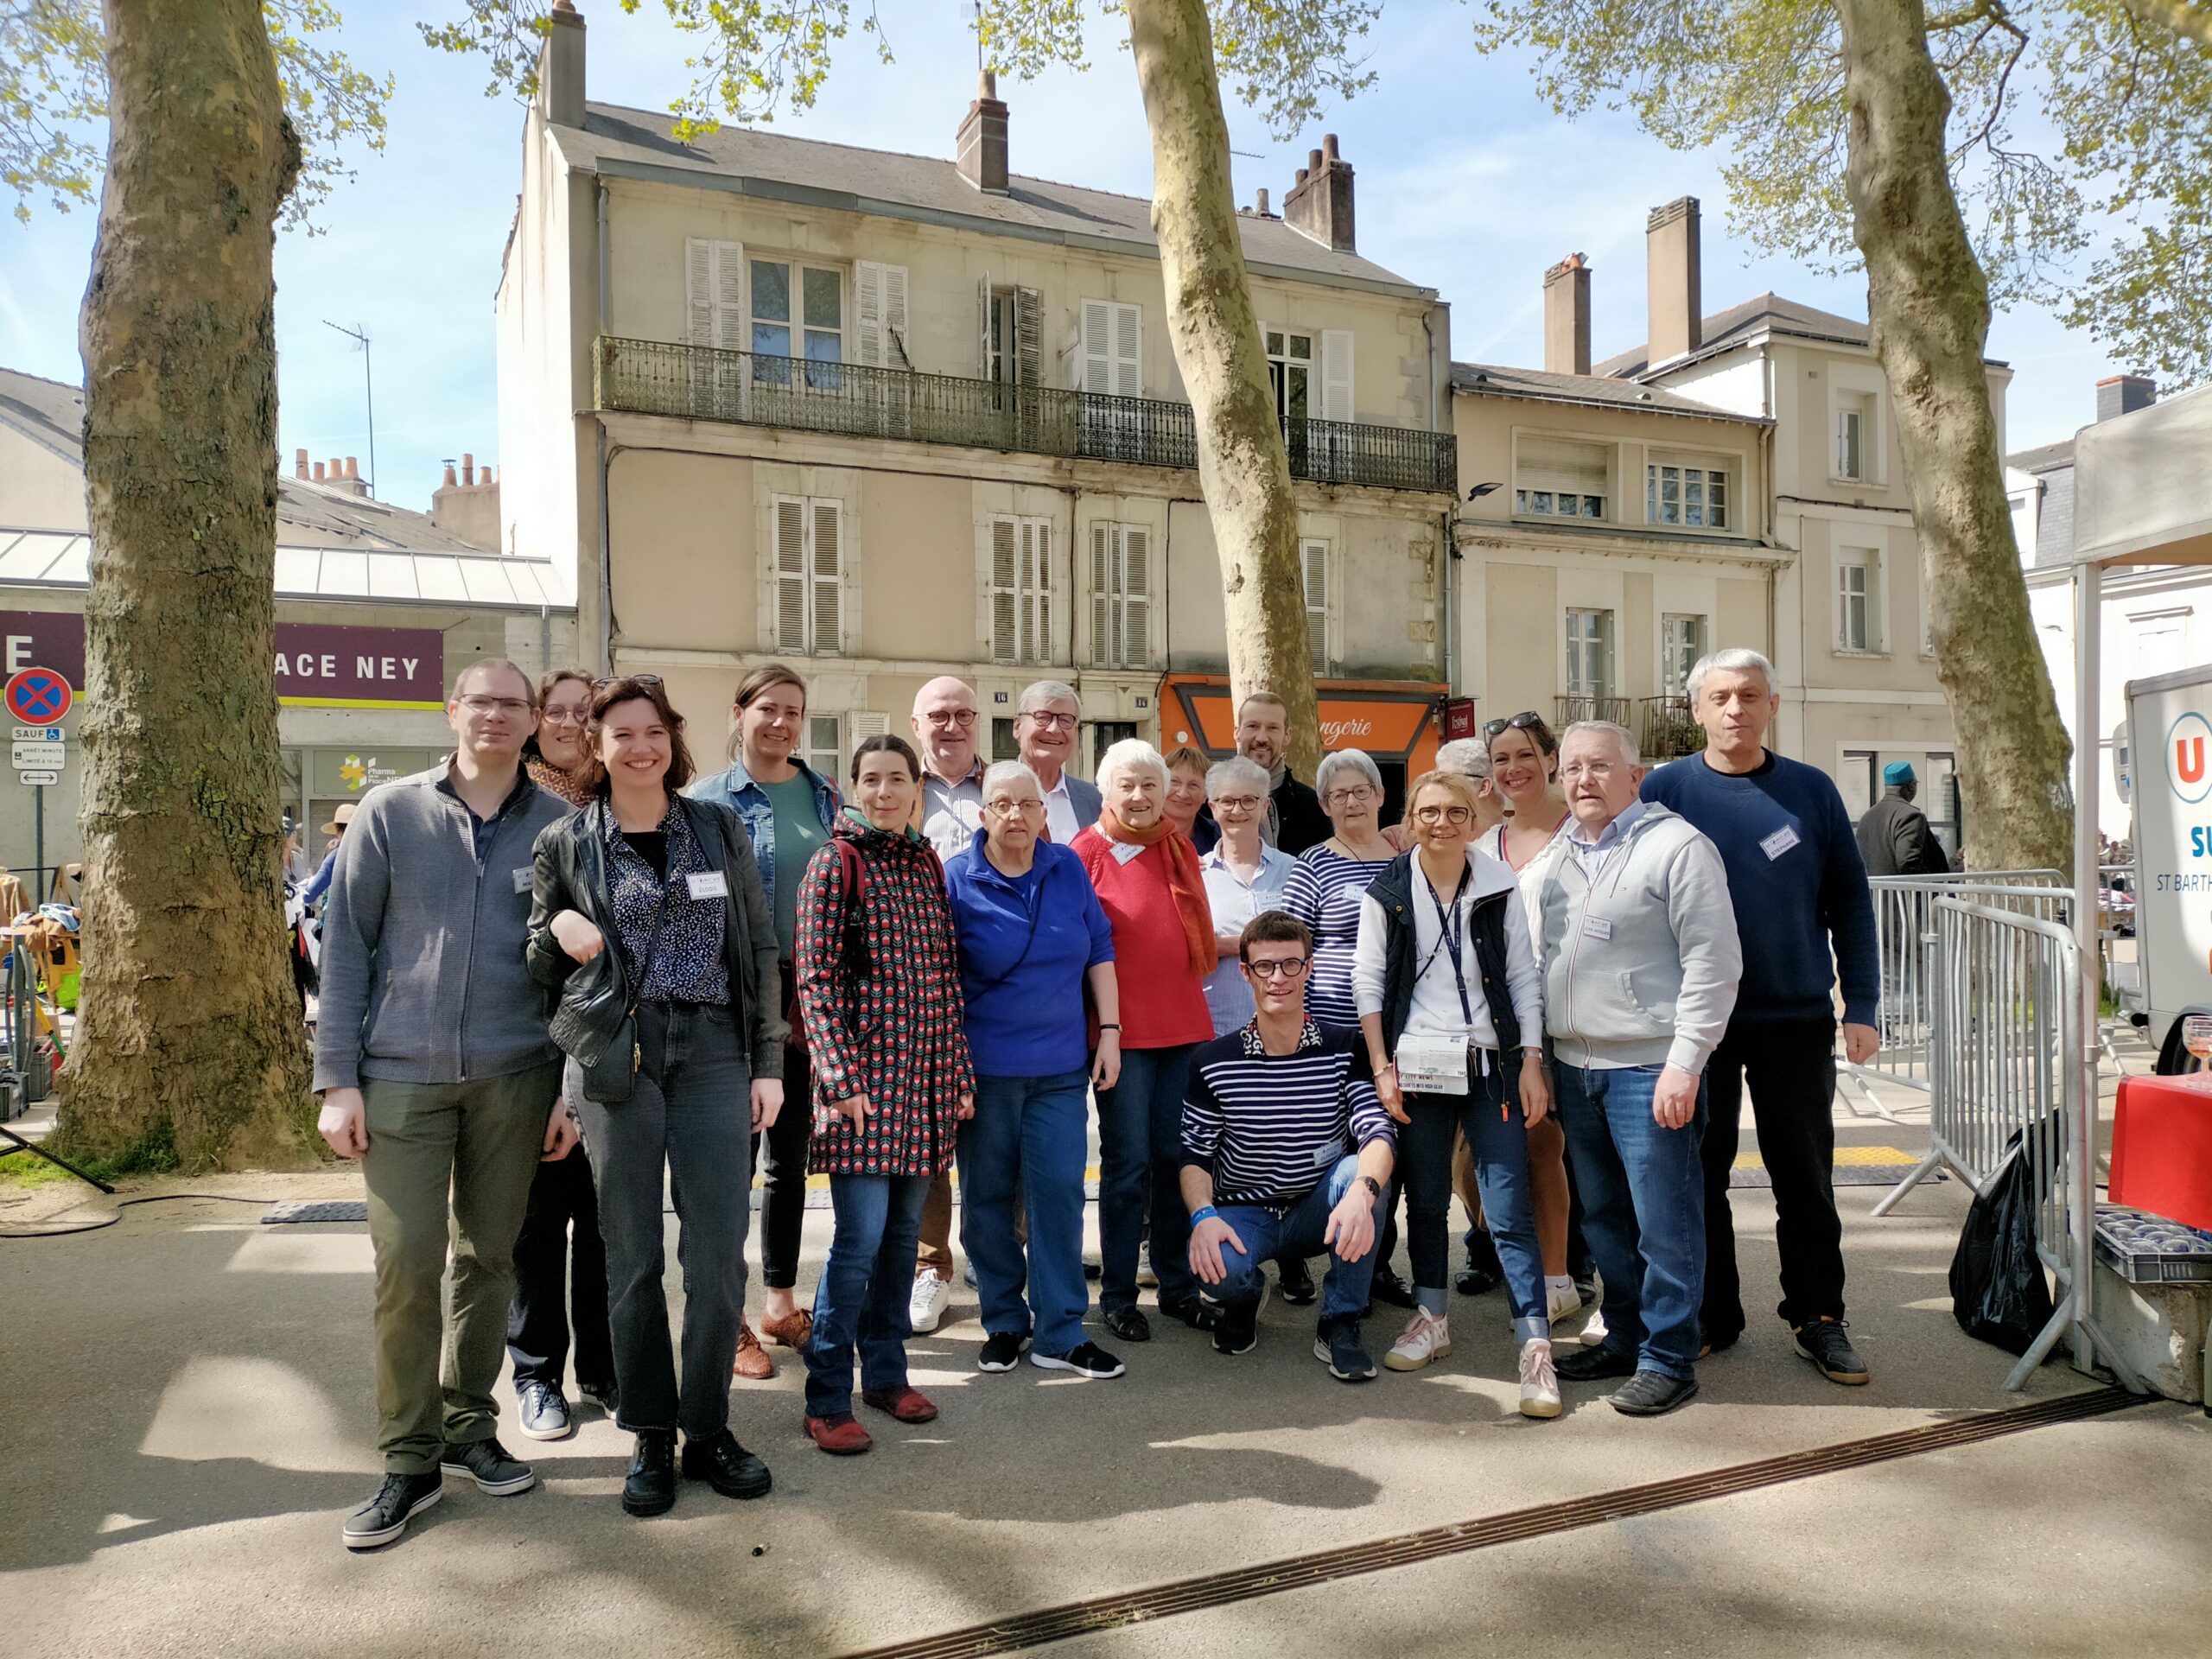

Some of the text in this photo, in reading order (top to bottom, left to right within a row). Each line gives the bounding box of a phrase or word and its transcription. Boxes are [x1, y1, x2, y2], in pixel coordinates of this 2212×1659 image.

[6, 635, 33, 674] E
[356, 656, 419, 680] NEY
[997, 693, 1007, 702] 16
[15, 729, 44, 738] SAUF
[2177, 736, 2205, 784] U
[2157, 874, 2171, 892] ST
